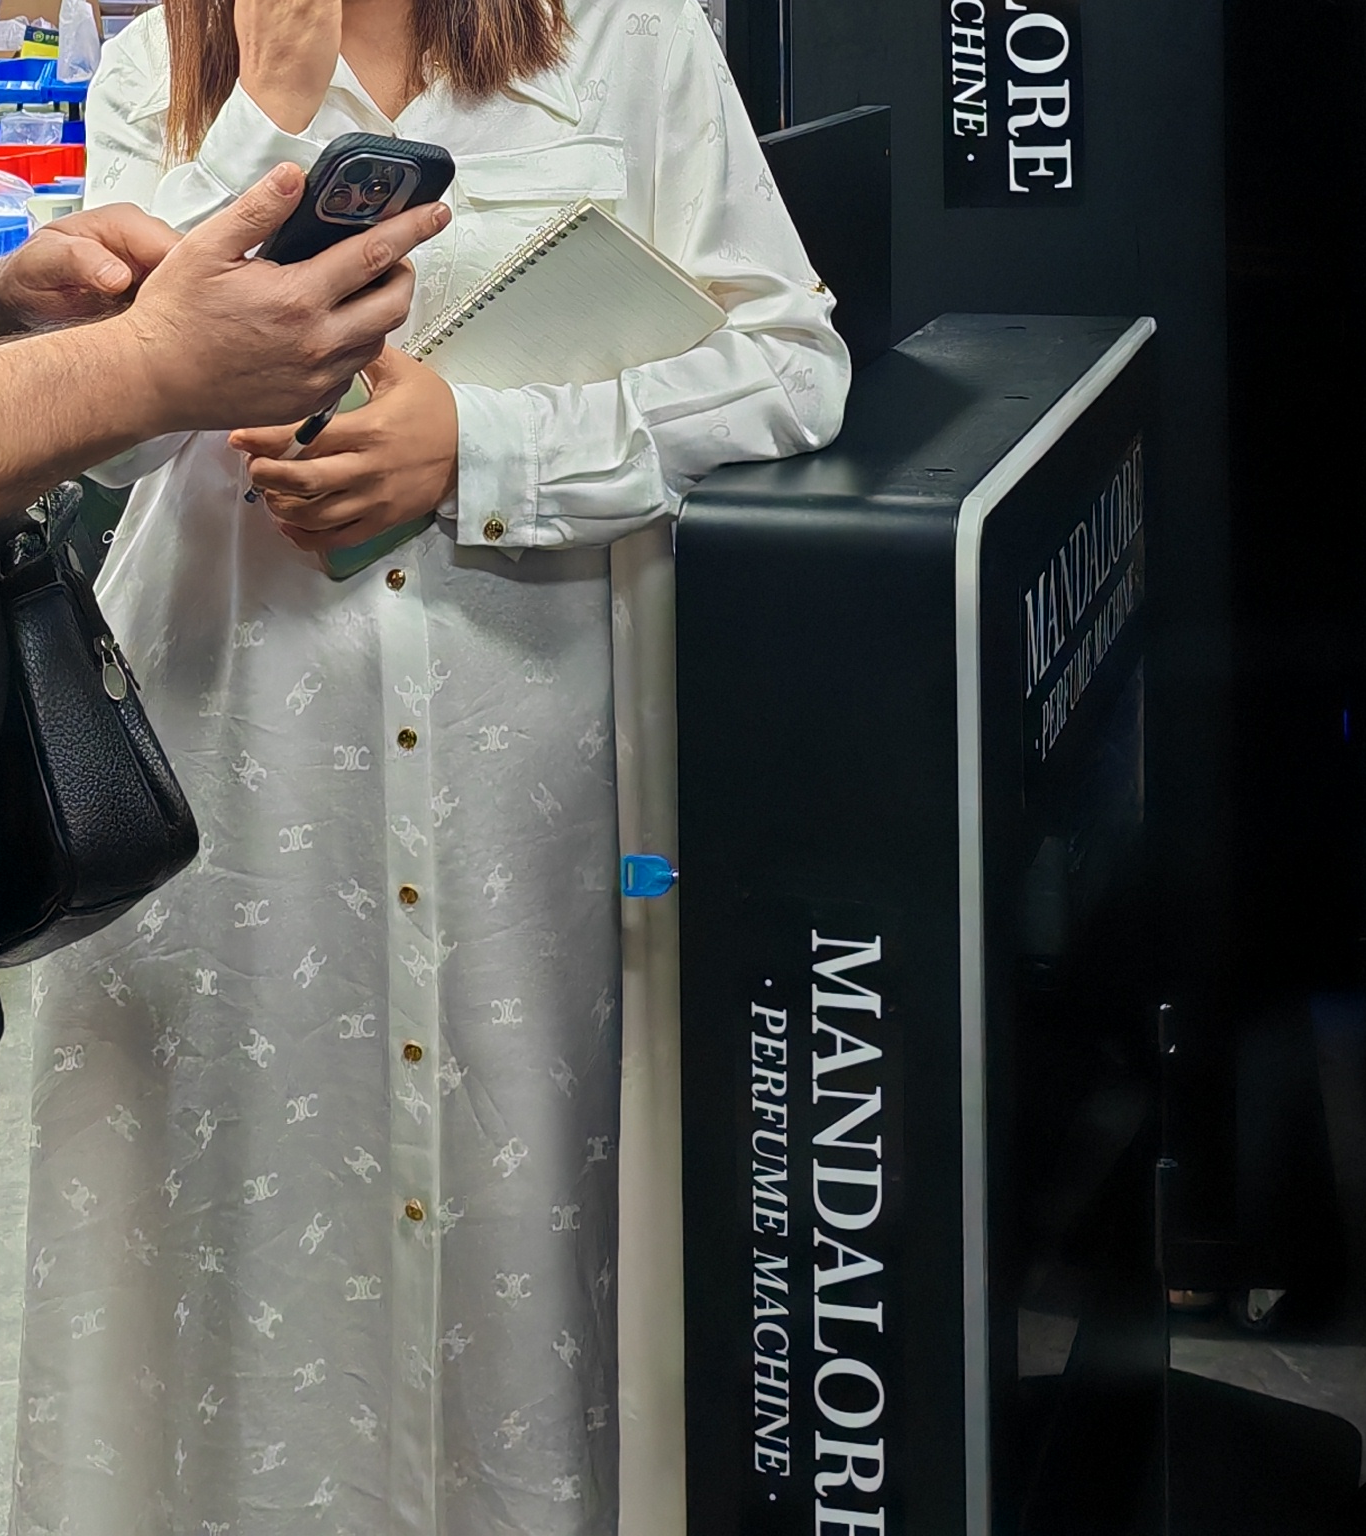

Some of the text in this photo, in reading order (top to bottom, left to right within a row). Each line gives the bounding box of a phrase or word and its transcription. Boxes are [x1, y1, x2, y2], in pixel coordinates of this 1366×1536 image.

[1024, 443, 1143, 700] MANDALORE
[1040, 630, 1094, 764] PERFUME
[751, 1000, 791, 1477] PERFUME MACHINE
[811, 928, 885, 1536] MANDALORE
